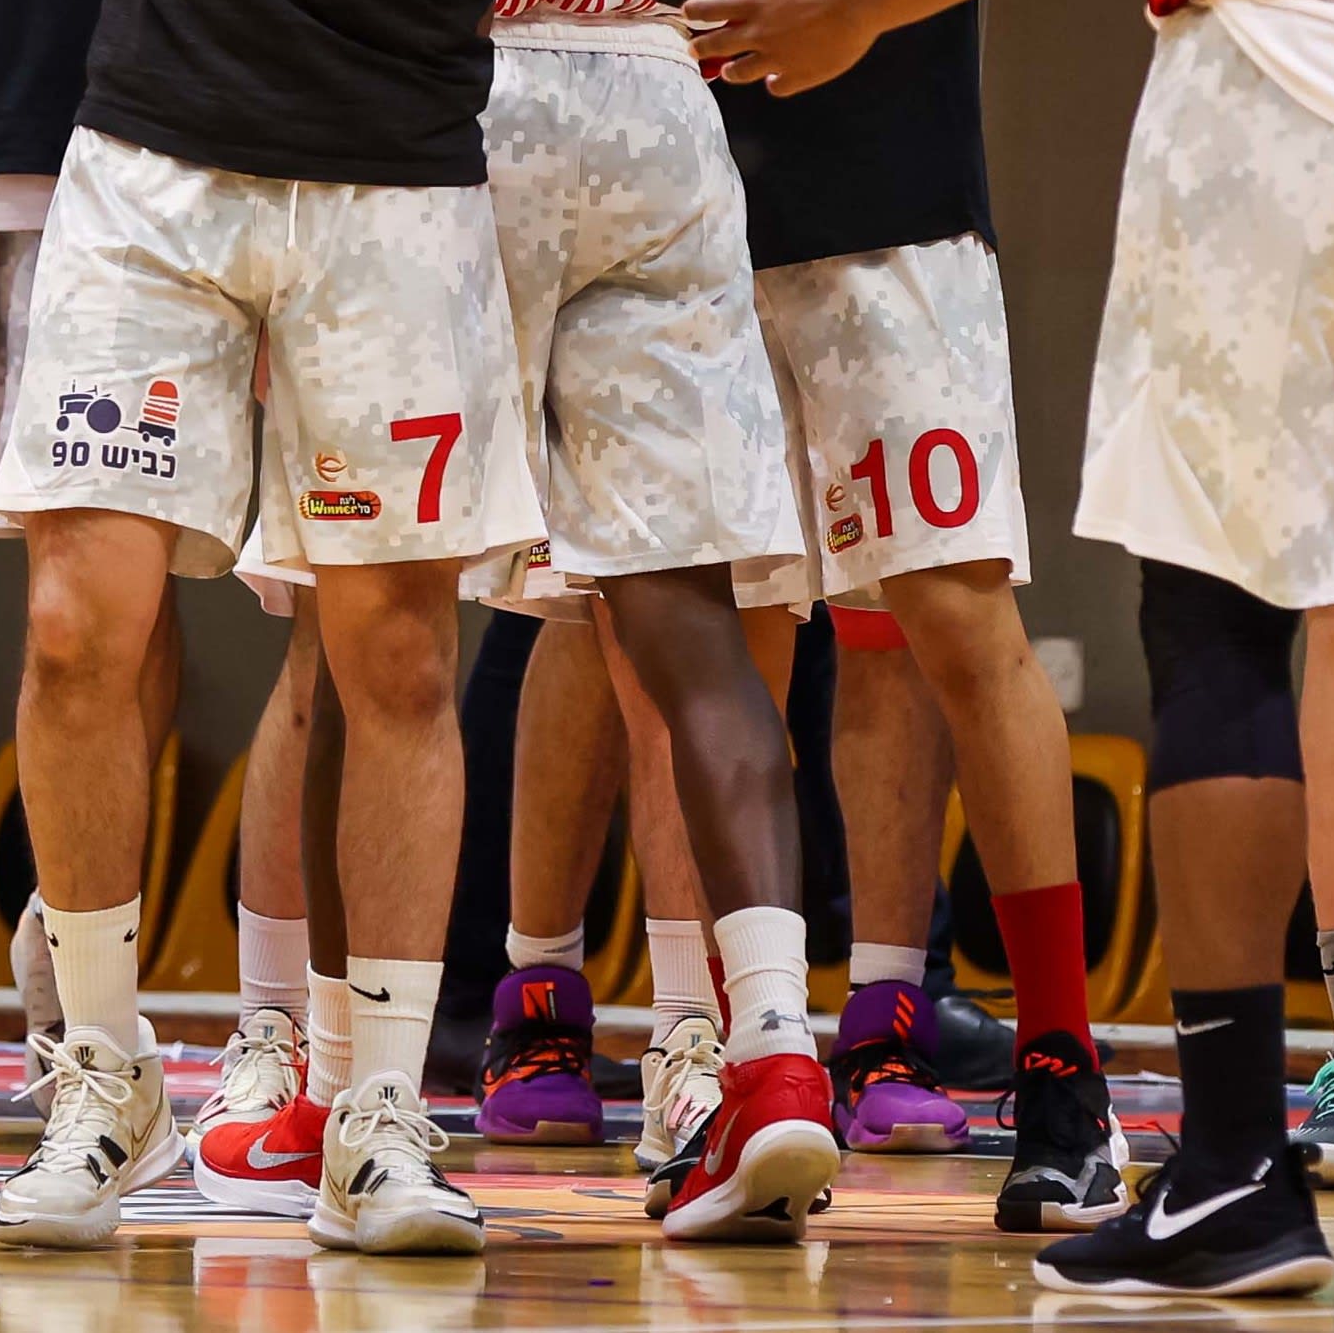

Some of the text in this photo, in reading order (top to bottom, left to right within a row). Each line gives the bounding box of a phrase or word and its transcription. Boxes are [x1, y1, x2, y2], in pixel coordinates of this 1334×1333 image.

[52, 441, 177, 479] כביש 90
[391, 413, 463, 524] 7
[850, 428, 980, 538] 10
